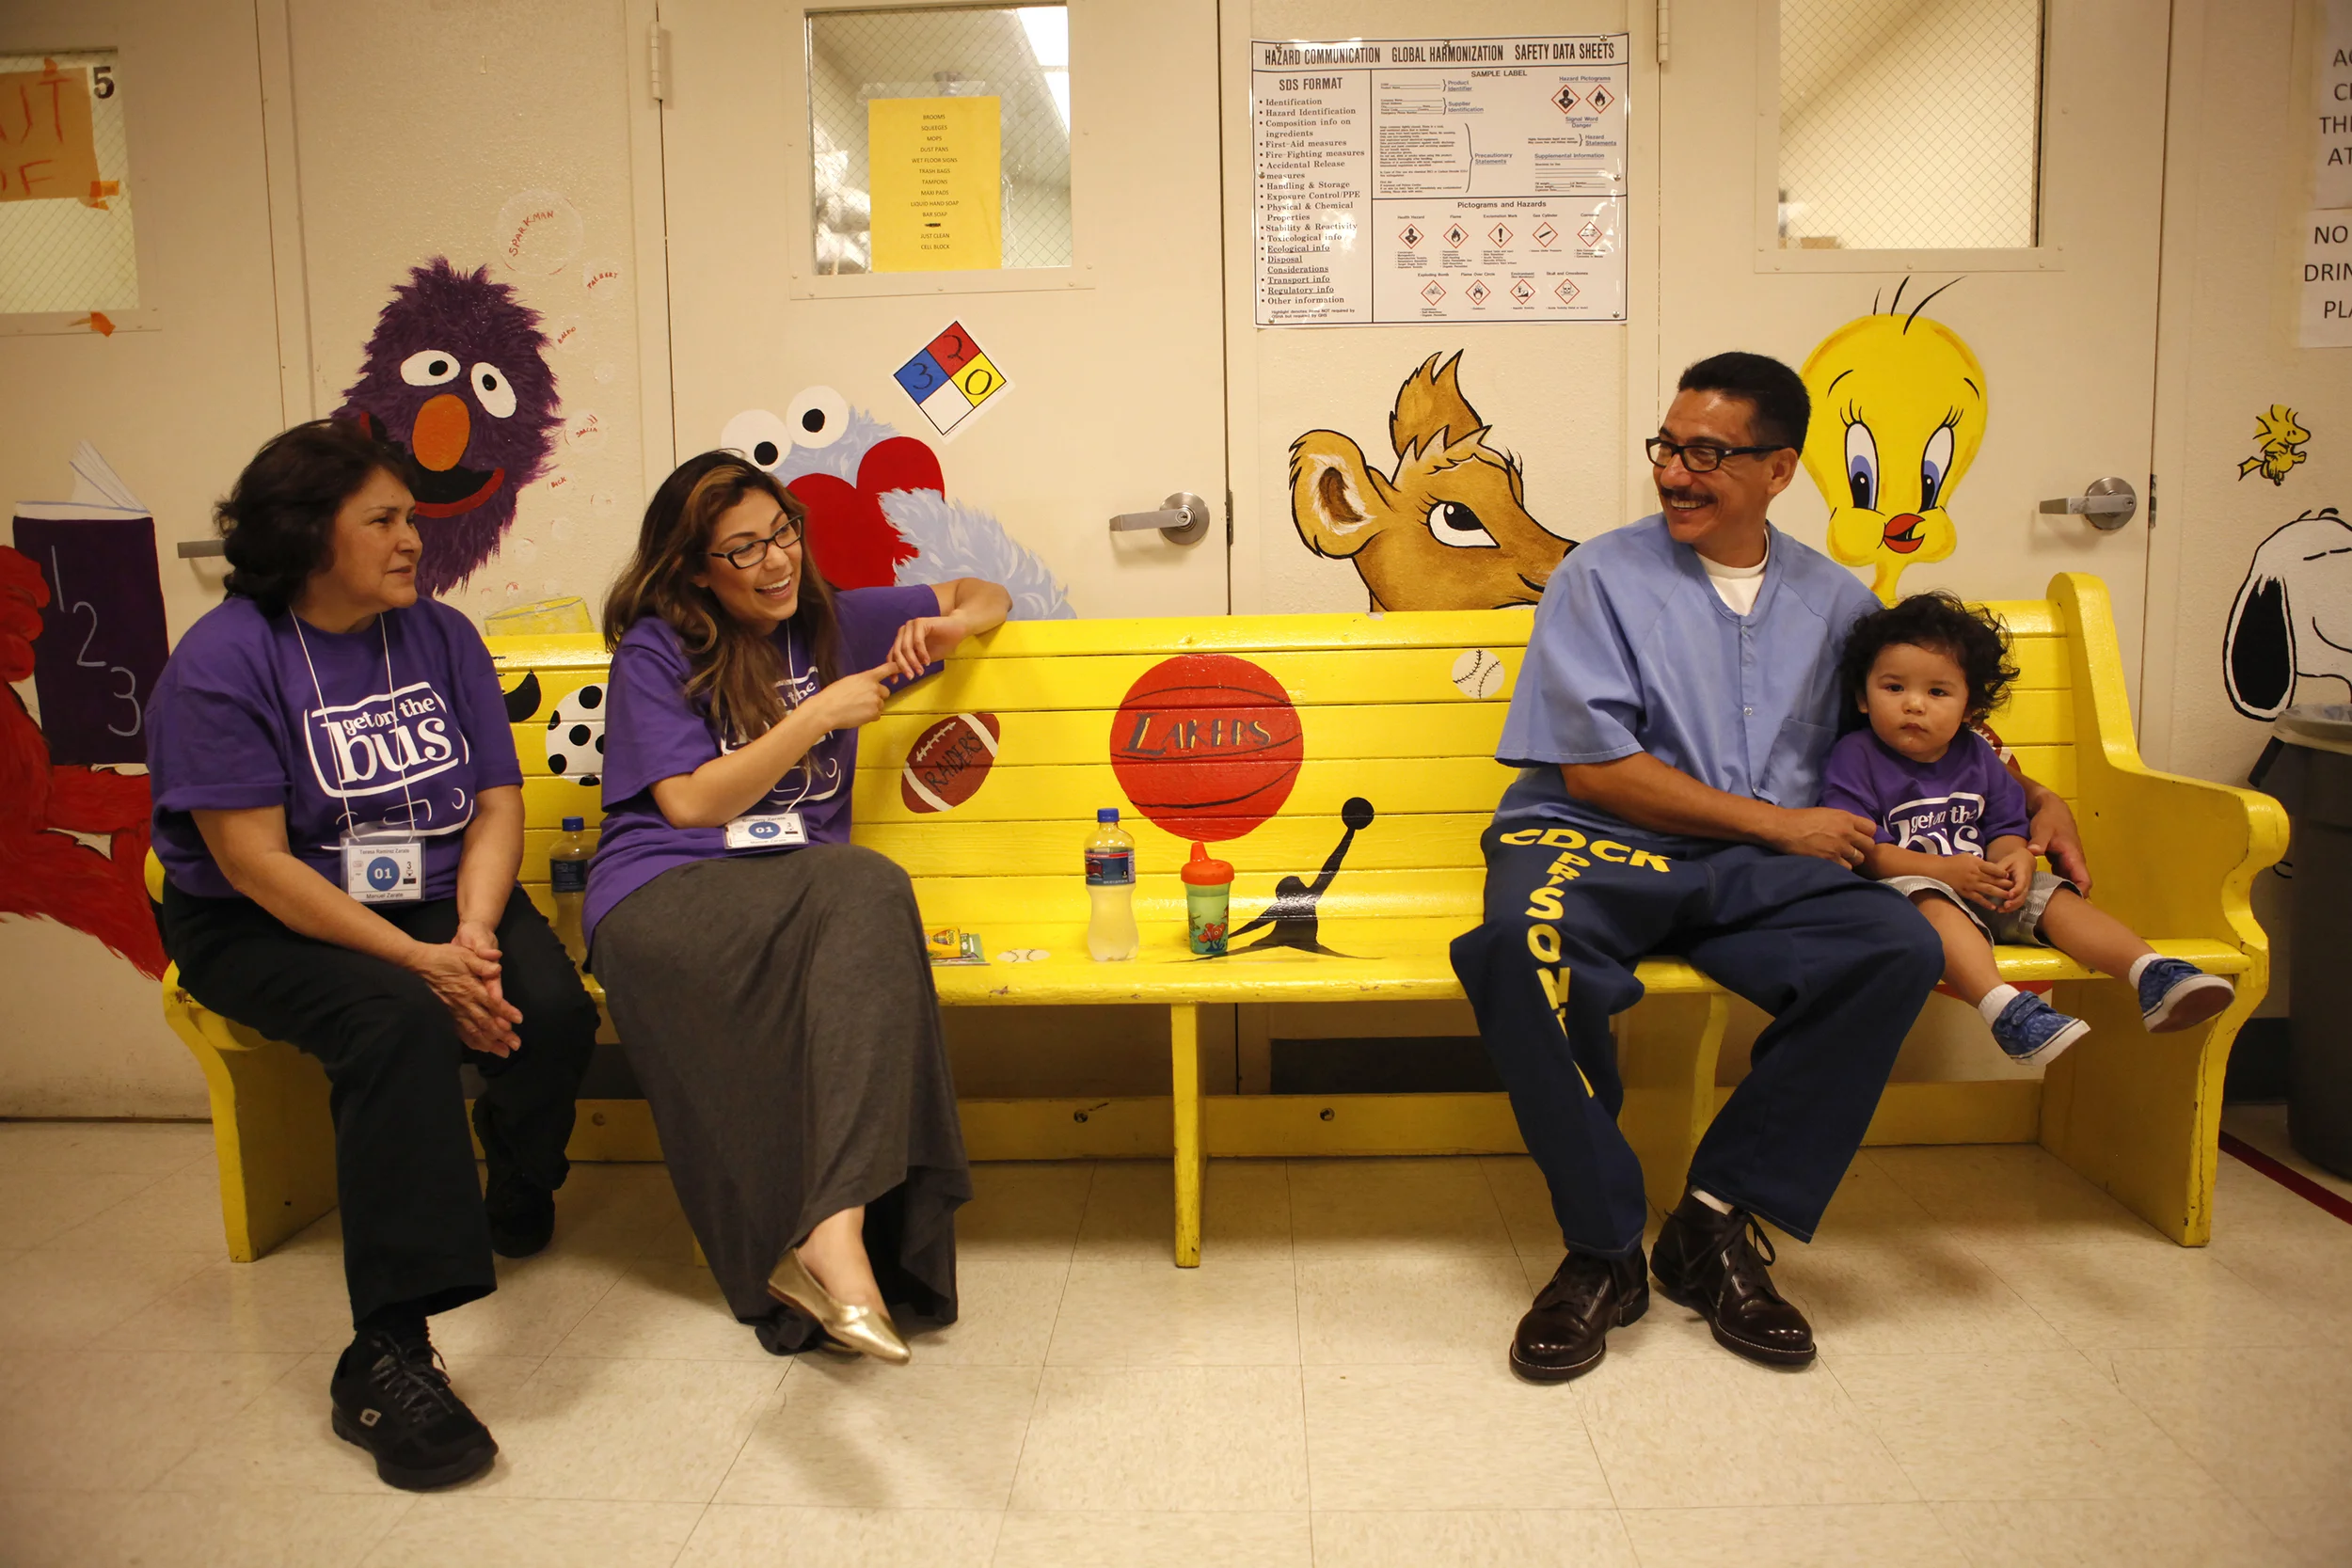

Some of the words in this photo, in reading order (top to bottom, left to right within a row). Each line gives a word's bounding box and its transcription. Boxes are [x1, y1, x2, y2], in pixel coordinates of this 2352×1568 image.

[1264, 49, 1300, 65] HAZARD
[1304, 47, 1380, 64] COMMUNICATION
[1392, 47, 1426, 62] GLOBAL
[1430, 45, 1503, 62] HARMONIZATION
[1515, 44, 1549, 60] SAFETY
[1552, 43, 1575, 59] DATA
[1580, 42, 1614, 58] SHEETS
[2333, 49, 2352, 67] A
[93, 66, 115, 100] 5
[1279, 79, 1298, 90] SDS
[1303, 77, 1343, 89] FORMAT
[2334, 83, 2352, 101] C
[1299, 107, 1356, 116] Identification
[1265, 119, 1316, 128] Composition
[1266, 130, 1313, 138] ingredients
[1265, 150, 1323, 159] Fire-Fighting
[1266, 161, 1310, 169] Accidental
[1319, 181, 1350, 189] Storage
[1267, 192, 1306, 201] Exposure
[1309, 191, 1360, 199] Control/PPE
[1267, 203, 1301, 212] Physical
[1267, 214, 1310, 222] Properties
[509, 211, 554, 257] SPARKMAN
[1267, 234, 1322, 243] Toxicological
[2314, 226, 2348, 244] NO
[1267, 245, 1310, 253] Ecological
[1267, 265, 1328, 274] Considerations
[1268, 287, 1313, 295] Regulatory
[2324, 300, 2352, 319] PL
[943, 335, 964, 361] 2
[913, 363, 933, 389] 3
[51, 546, 65, 612] 1
[72, 601, 107, 667] 2
[107, 666, 141, 737] 3
[342, 711, 374, 736] get
[399, 698, 436, 718] the
[1121, 712, 1271, 755] LAKERS
[320, 718, 452, 784] bus
[925, 731, 982, 794] RAIDERS
[1911, 814, 1934, 833] get
[1949, 805, 1978, 824] the
[374, 868, 392, 879] 01
[1524, 852, 1595, 1099] PRISON
